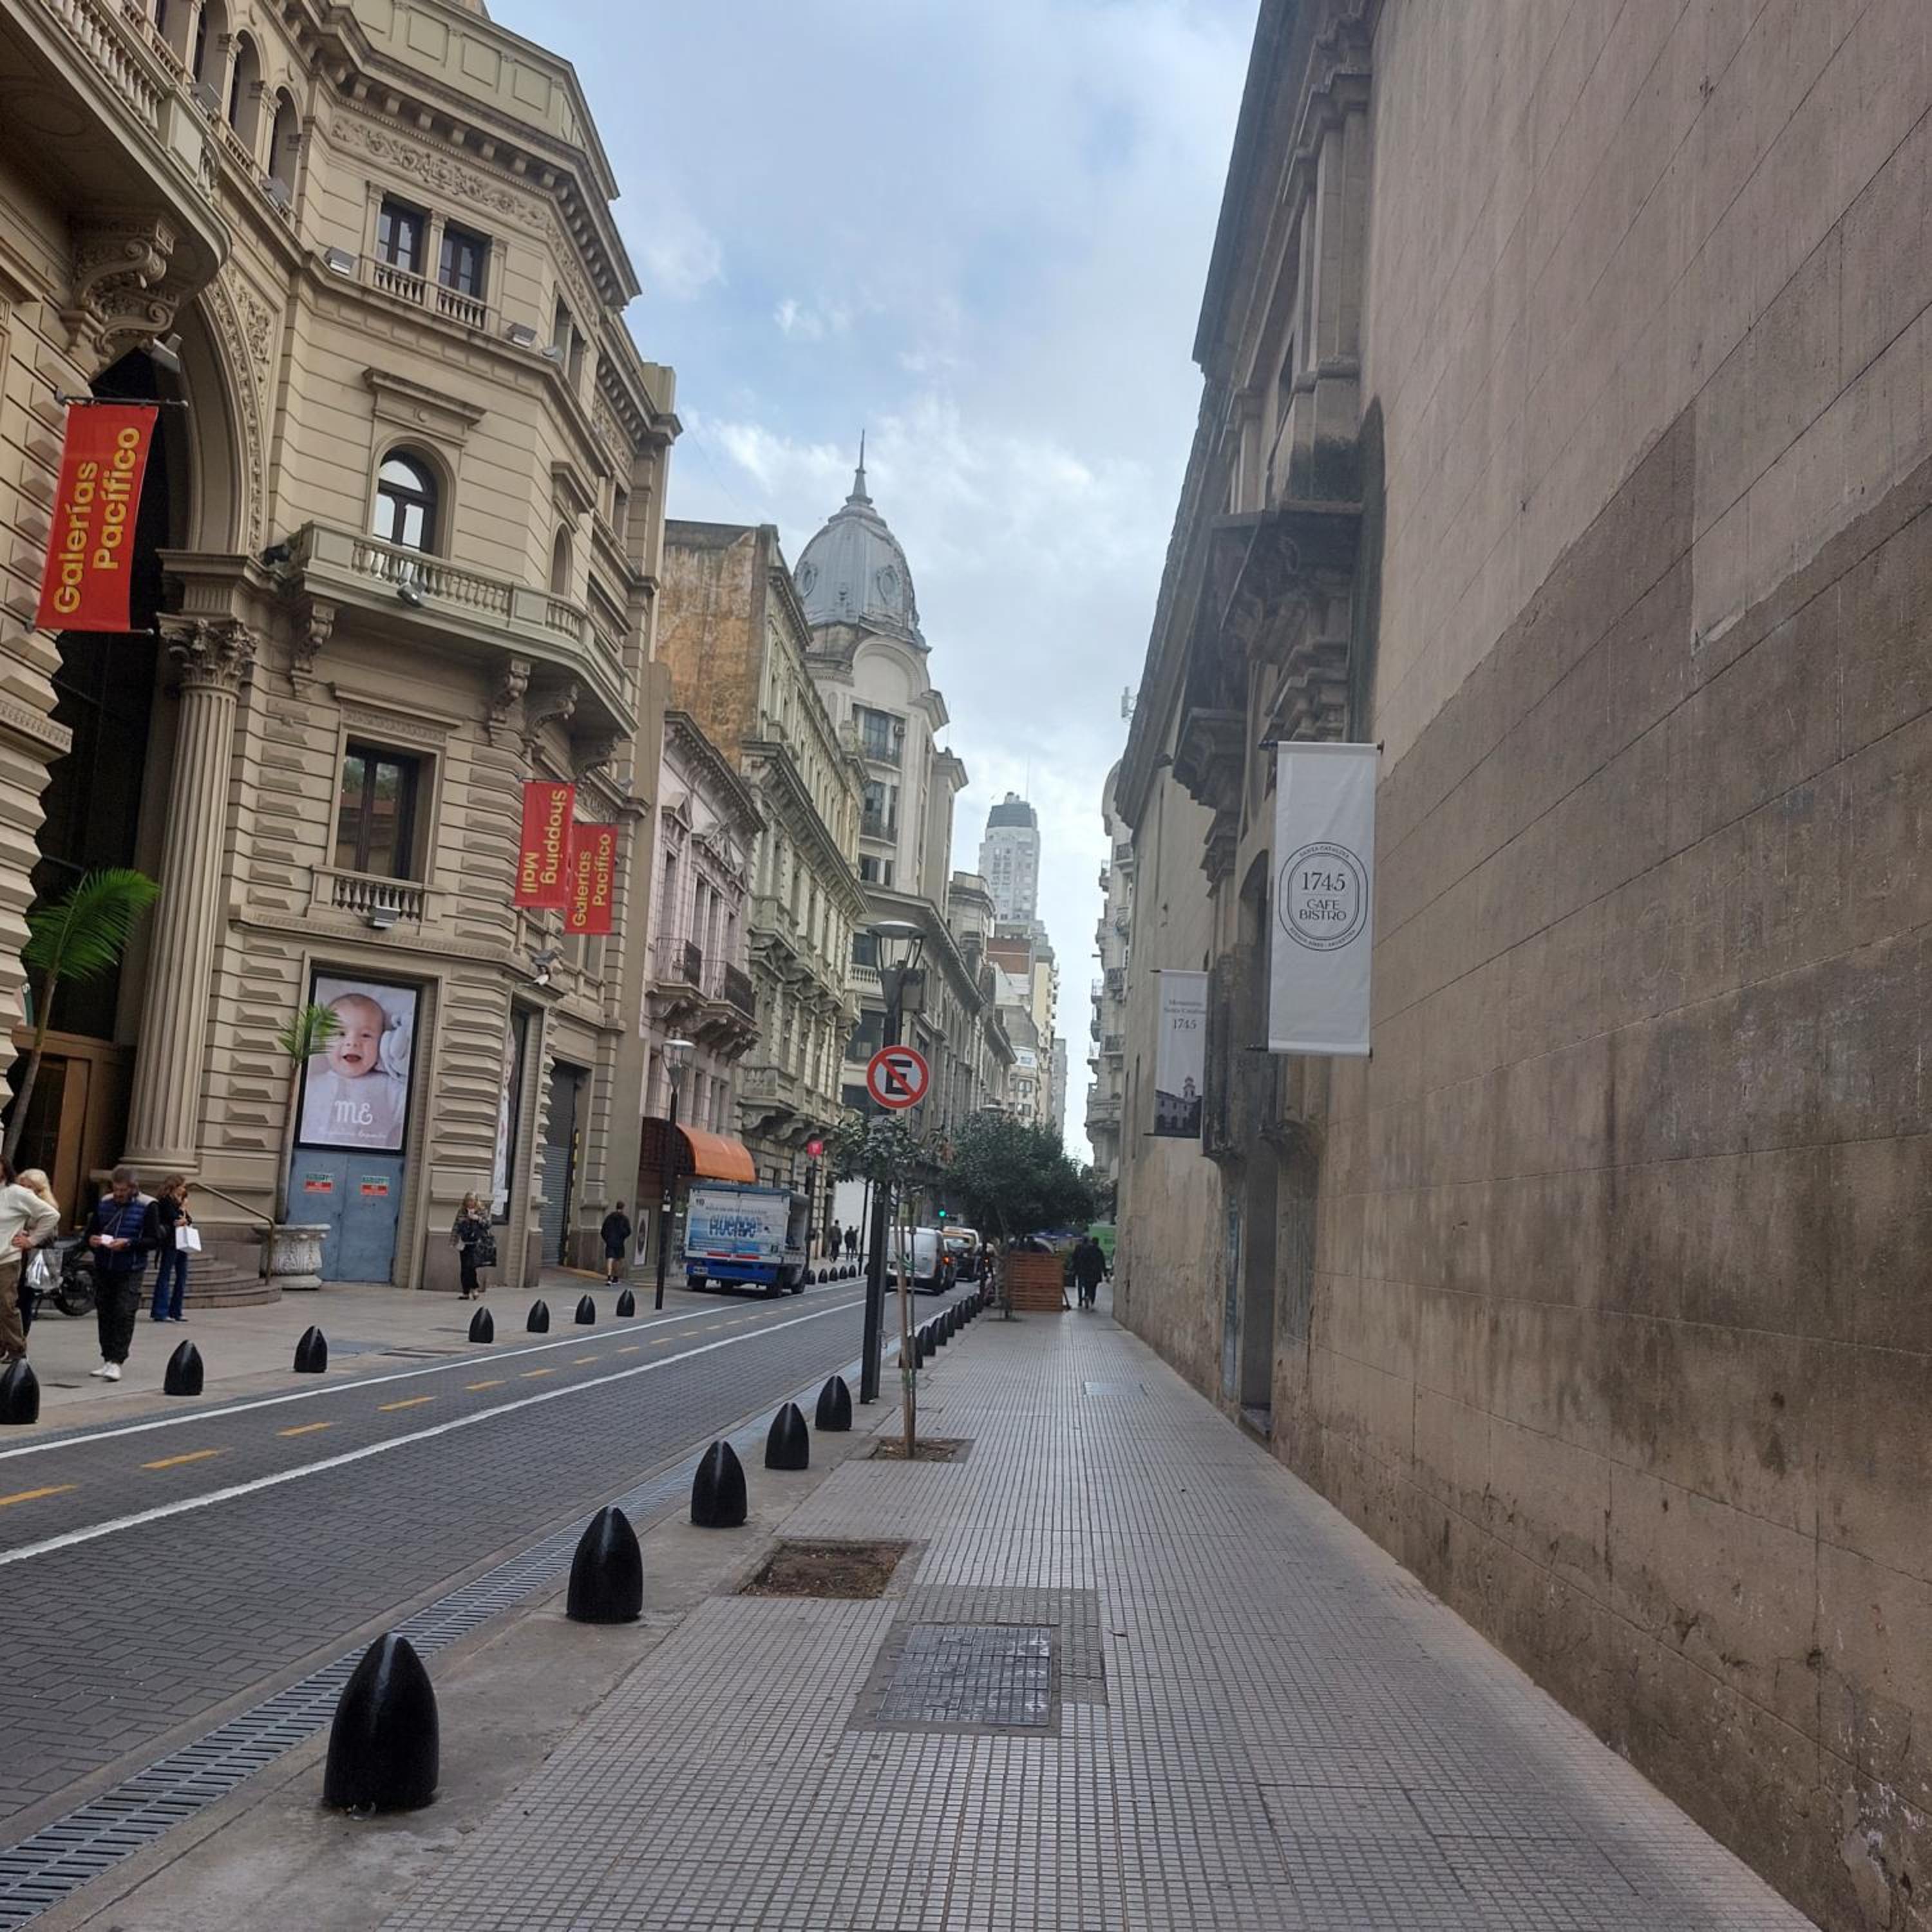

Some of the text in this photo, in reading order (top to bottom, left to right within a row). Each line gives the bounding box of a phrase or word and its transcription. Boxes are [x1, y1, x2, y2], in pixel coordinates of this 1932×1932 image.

[93, 427, 140, 570] Pacífico
[53, 461, 98, 613] Galerías
[540, 790, 567, 885] Shopping
[521, 852, 540, 893] Mall
[573, 851, 592, 926] Galerías
[592, 833, 611, 907] Pacífico
[1302, 871, 1346, 892] 1745
[1299, 909, 1347, 921] BISTRO
[1307, 898, 1340, 910] CAFE
[1173, 1018, 1197, 1030] 1745
[885, 1059, 913, 1095] E
